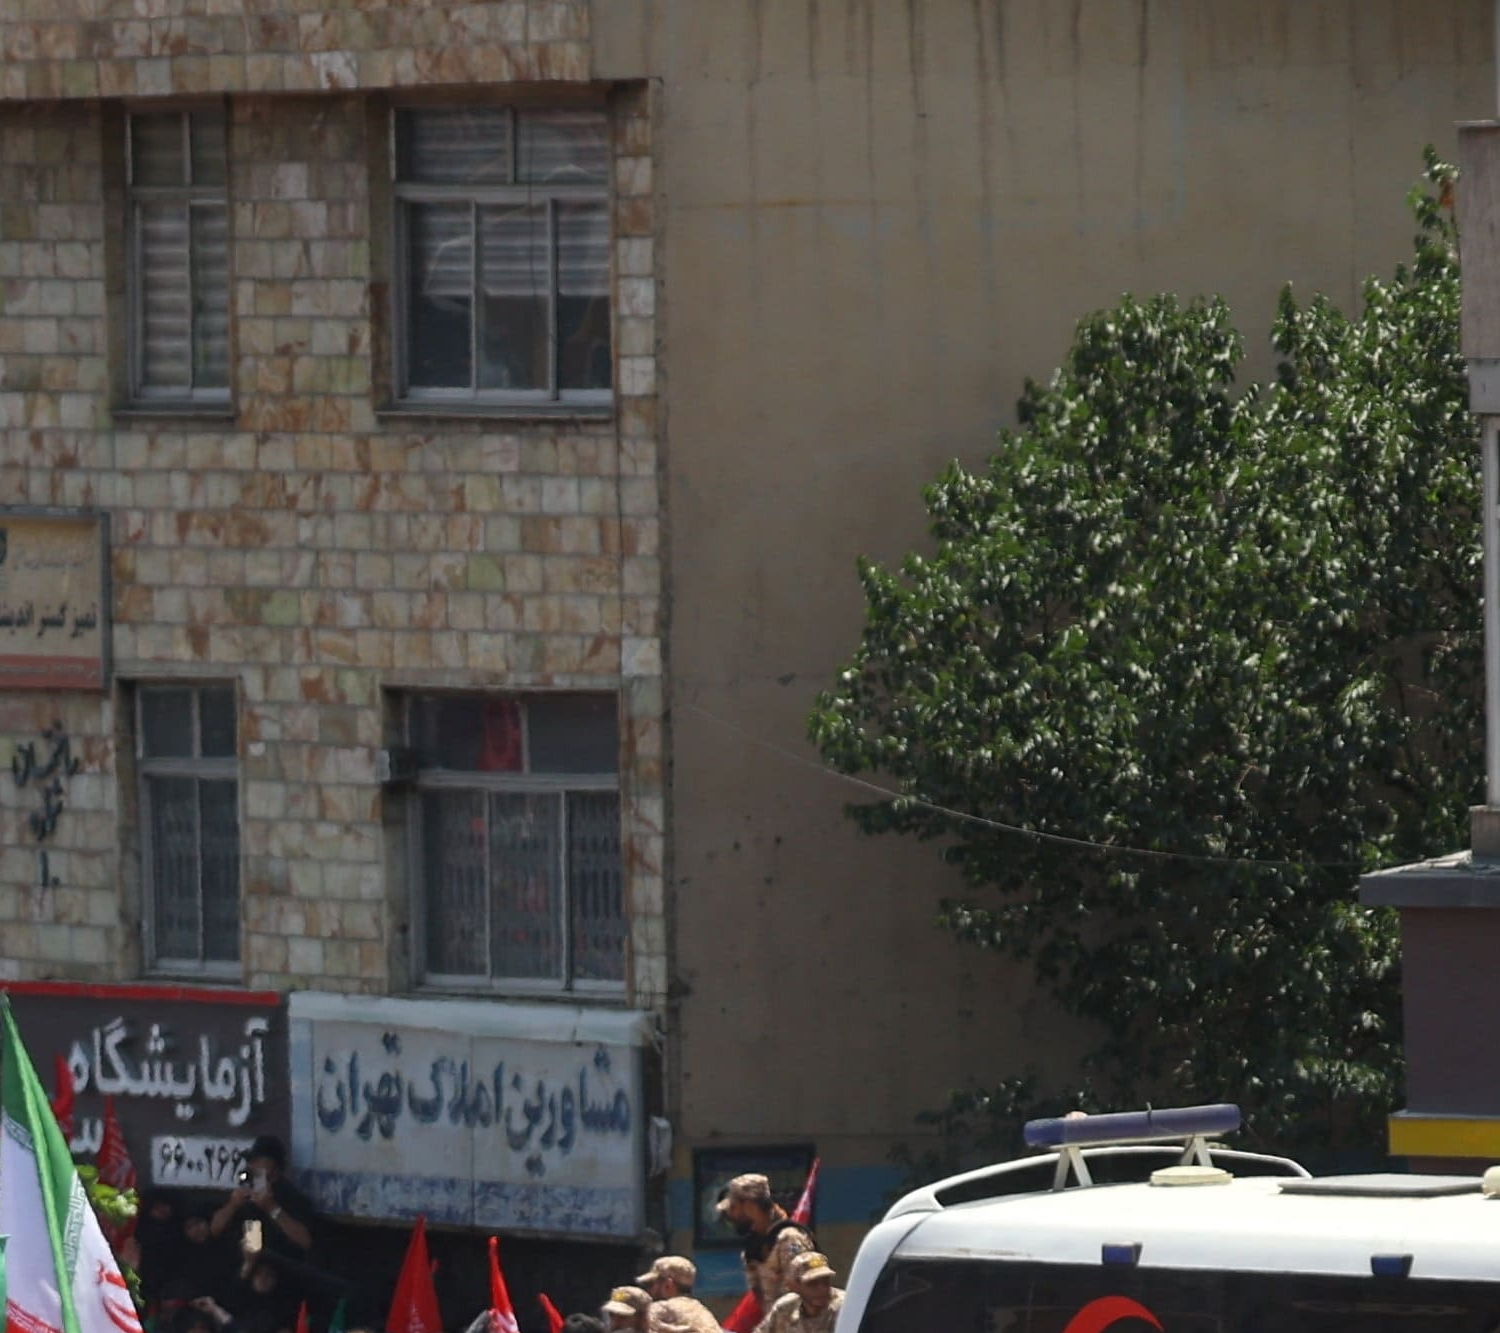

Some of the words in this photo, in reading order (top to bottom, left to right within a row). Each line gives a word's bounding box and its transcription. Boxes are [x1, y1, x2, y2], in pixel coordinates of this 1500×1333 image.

[69, 1016, 269, 1127] آزمایشگاه
[317, 1031, 402, 1142] تهران
[407, 1055, 504, 1128] املاک
[505, 1046, 630, 1178] مشاورین
